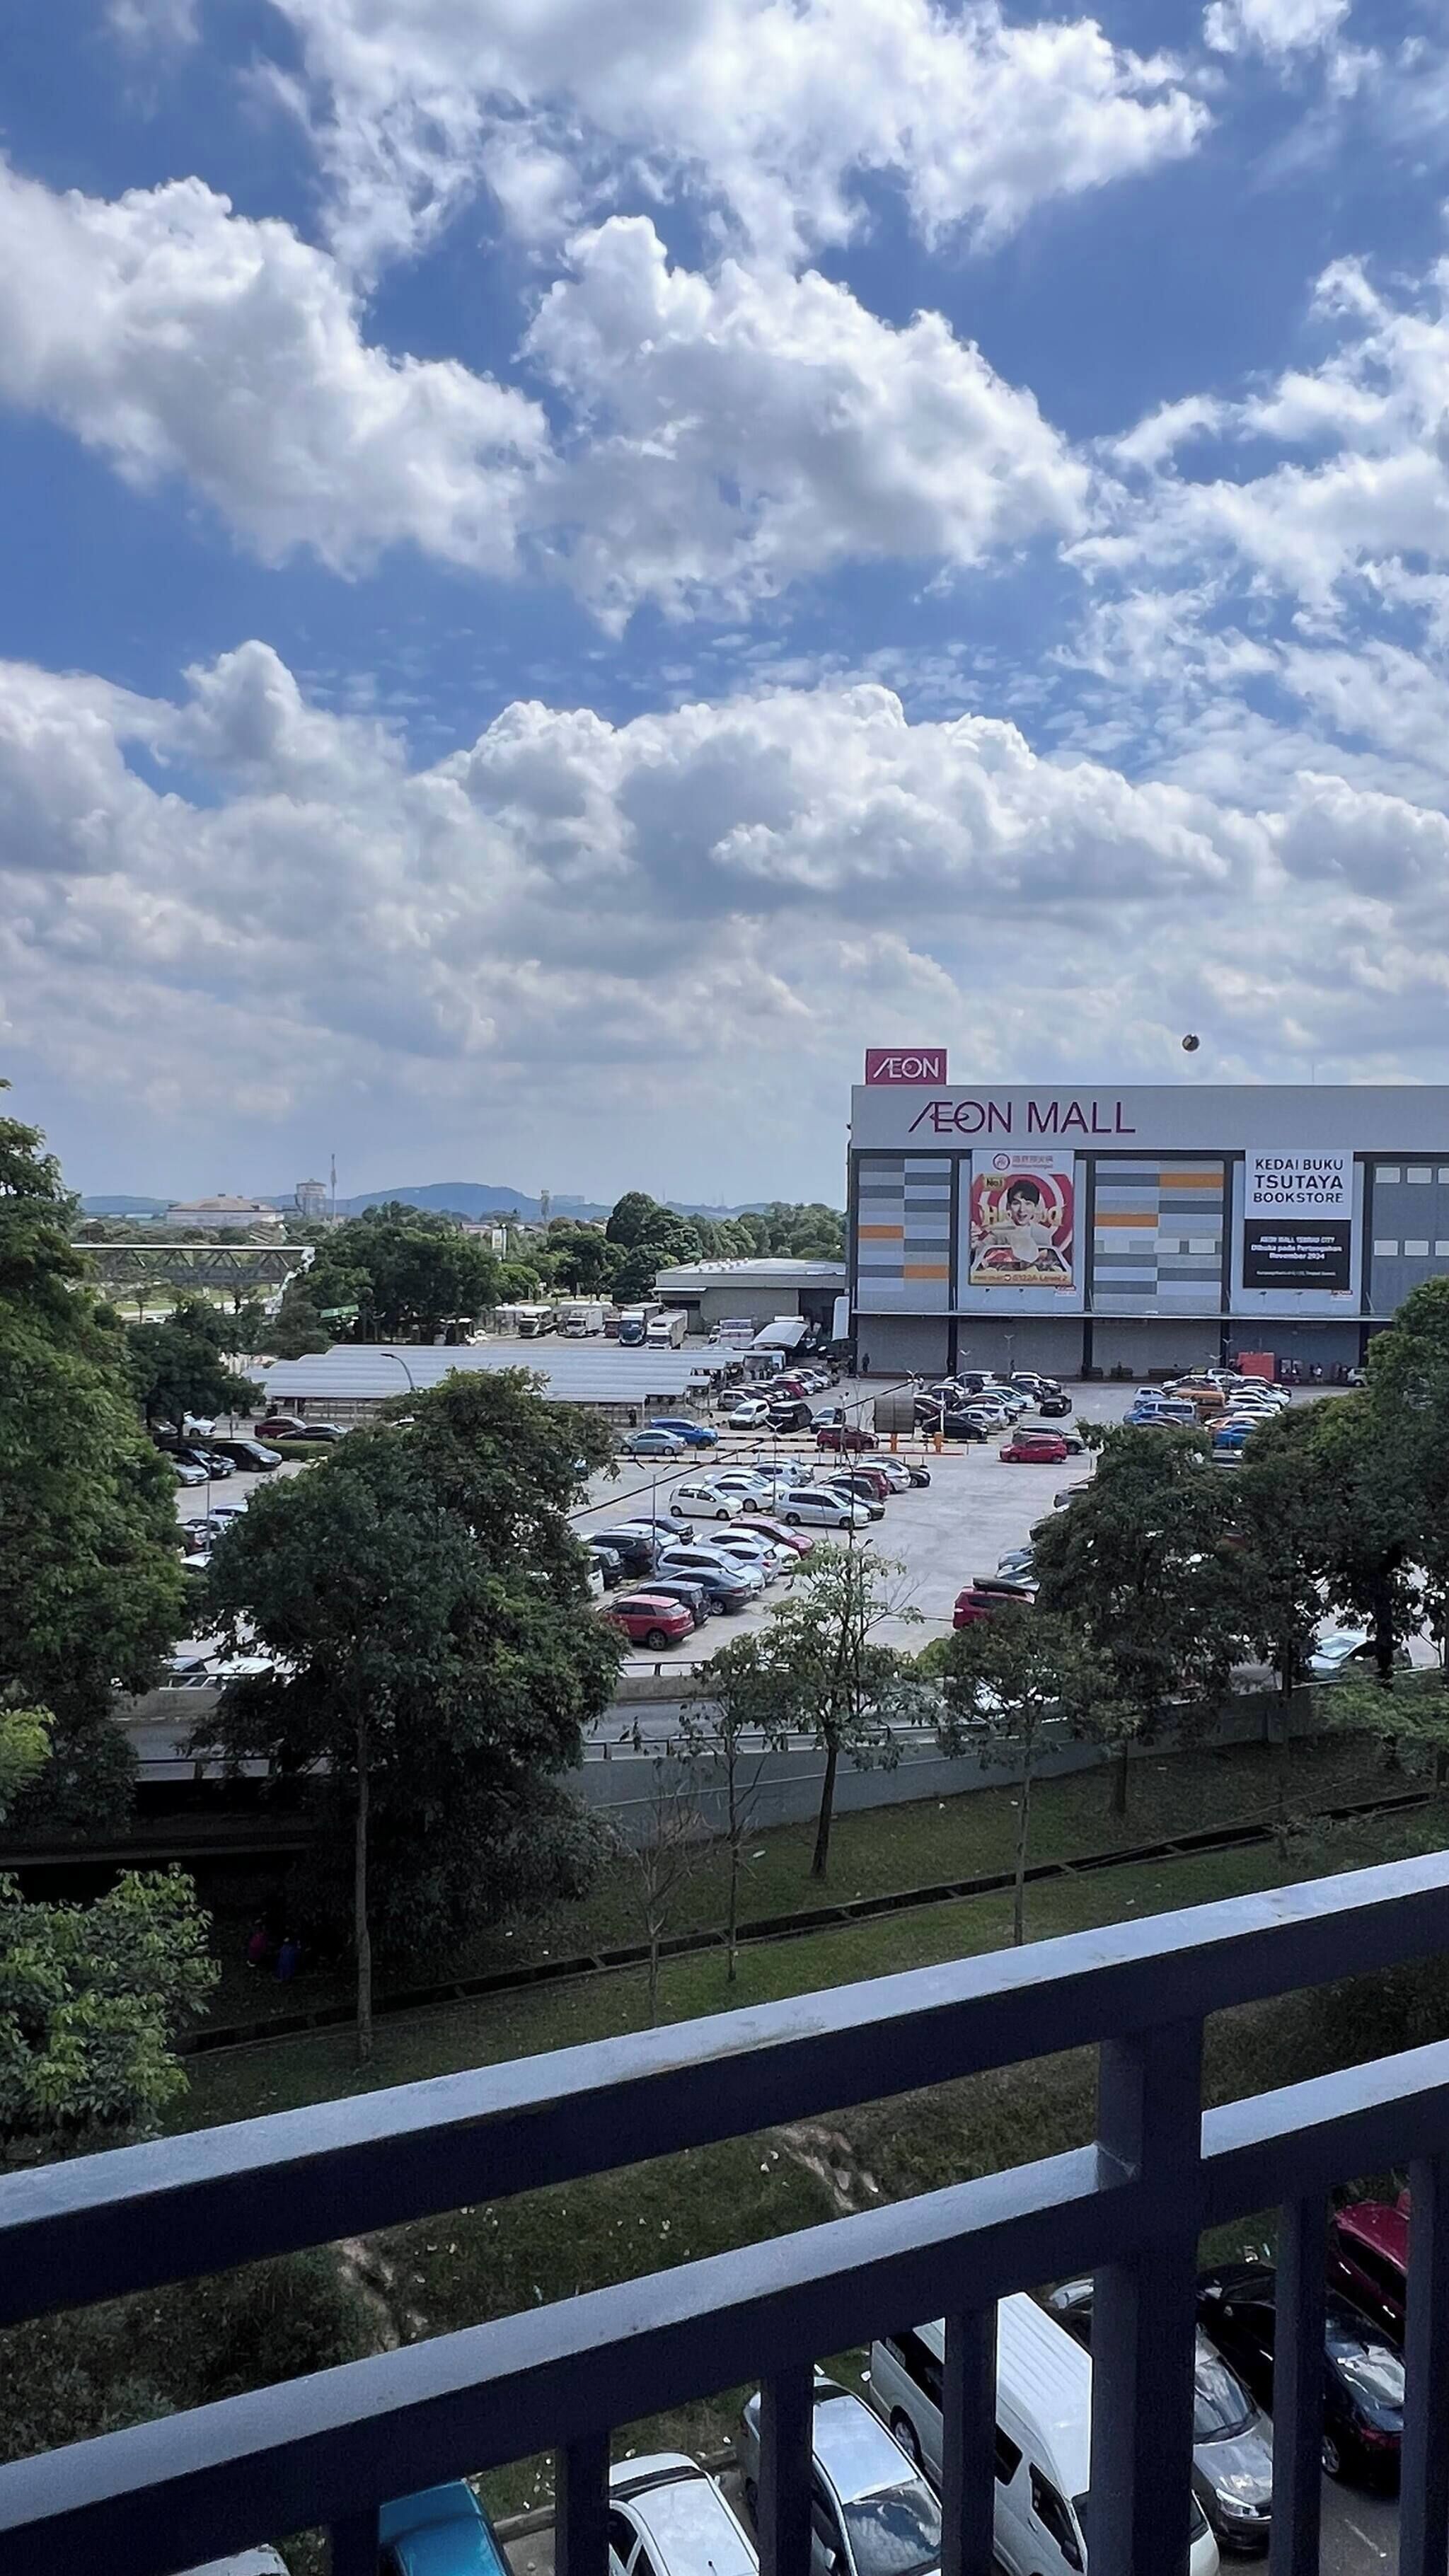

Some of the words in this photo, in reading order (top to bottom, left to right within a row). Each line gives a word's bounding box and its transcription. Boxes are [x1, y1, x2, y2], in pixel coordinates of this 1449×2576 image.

[1028, 1101, 1136, 1133] MALL
[1255, 1159, 1299, 1170] KEDAI
[1303, 1159, 1344, 1170] BUKU
[1254, 1174, 1344, 1189] TSUTAYA
[1253, 1192, 1344, 1203] BOOKSTORE
